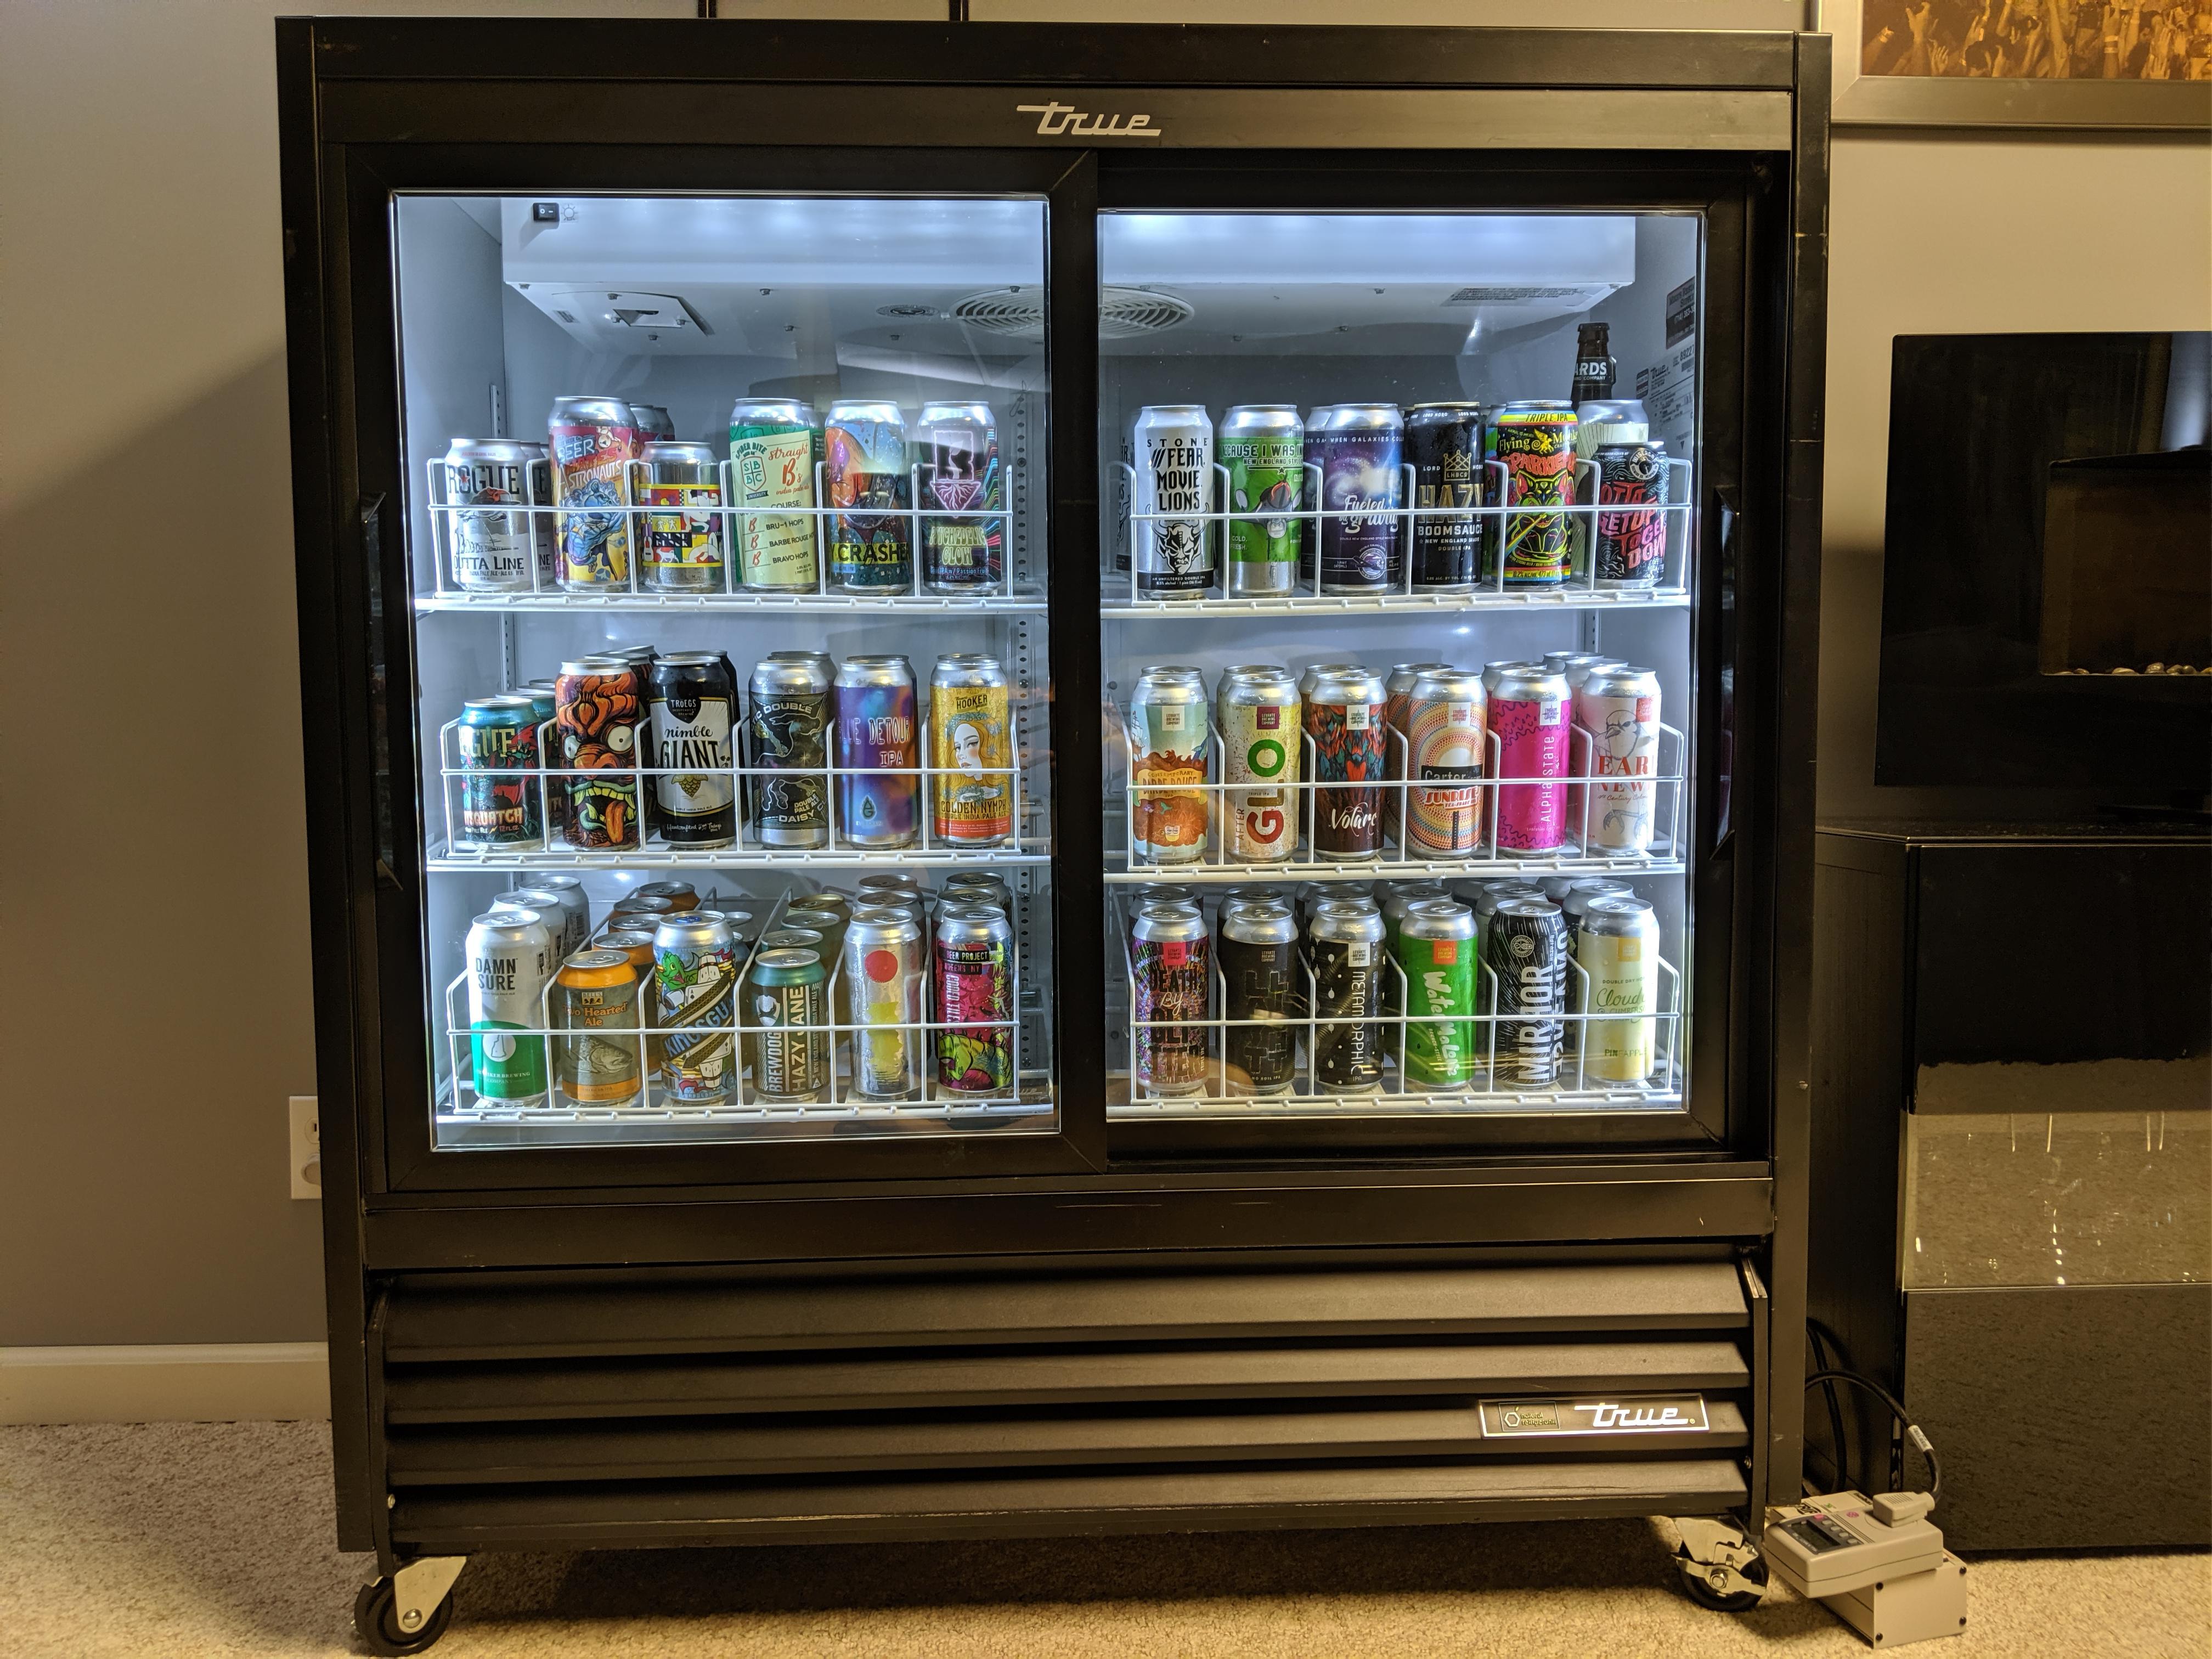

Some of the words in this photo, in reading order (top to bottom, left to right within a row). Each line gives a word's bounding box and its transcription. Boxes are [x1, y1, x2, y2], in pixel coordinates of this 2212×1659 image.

[1526, 413, 1555, 422] TRIPLE
[1557, 413, 1568, 422] IPA
[1147, 437, 1209, 448] STONE
[1499, 437, 1531, 453] Flying
[735, 442, 751, 460] SPIDER
[769, 442, 808, 461] straight
[1262, 444, 1267, 457] I
[1270, 444, 1295, 457] WAS
[744, 463, 749, 471] S
[753, 460, 760, 470] B
[447, 465, 520, 494] ROGUE
[746, 476, 753, 484] B
[755, 473, 762, 482] C
[747, 491, 767, 500] UNIVERSITY
[776, 486, 792, 495] india
[1158, 491, 1200, 512] LIONS
[1344, 494, 1386, 511] Fueled
[1418, 483, 1484, 523] HAZY
[766, 522, 787, 531] BRU-1
[789, 518, 804, 527] HOPS
[1418, 524, 1483, 536] BOOMSAUCE
[769, 537, 791, 548] BARBE
[792, 534, 810, 544] ROUGE
[454, 556, 489, 570] OUTTA
[494, 556, 524, 571] LINE
[772, 554, 794, 564] BRAVO
[795, 551, 809, 560] HOPS
[942, 546, 973, 566] GLOW
[763, 702, 812, 714] DOUBLE
[956, 694, 988, 709] HOOKER
[664, 725, 714, 738] nimble
[869, 716, 910, 744] DETOUR
[660, 740, 719, 769] GIANT
[879, 751, 904, 766] IPA
[1425, 770, 1466, 780] Carter
[794, 793, 817, 808] DOUBLE
[1425, 787, 1478, 804] SUNRISE
[1607, 793, 1631, 802] Century
[794, 804, 810, 814] PALE
[811, 796, 820, 808] ALE
[941, 800, 977, 814] GOLDEN
[980, 799, 1006, 814] NYMPH
[778, 809, 815, 823] DAISY
[941, 812, 962, 820] DOUBLE
[1329, 802, 1377, 837] Volare
[667, 823, 697, 832] Handcrafted
[1236, 809, 1245, 840] AFTER
[946, 951, 960, 961] BEER
[962, 951, 988, 961] PROJECT
[475, 957, 516, 974] DAMN
[944, 962, 966, 973] QUEENS
[970, 964, 979, 972] NY
[478, 974, 515, 991] SURE
[584, 1002, 627, 1017] Hearted
[1160, 991, 1183, 1016] By
[584, 1017, 603, 1027] Ale
[1604, 1048, 1647, 1057] PINEAPPLE
[767, 1030, 783, 1093] BREWDOG
[791, 1040, 806, 1092] HAZY
